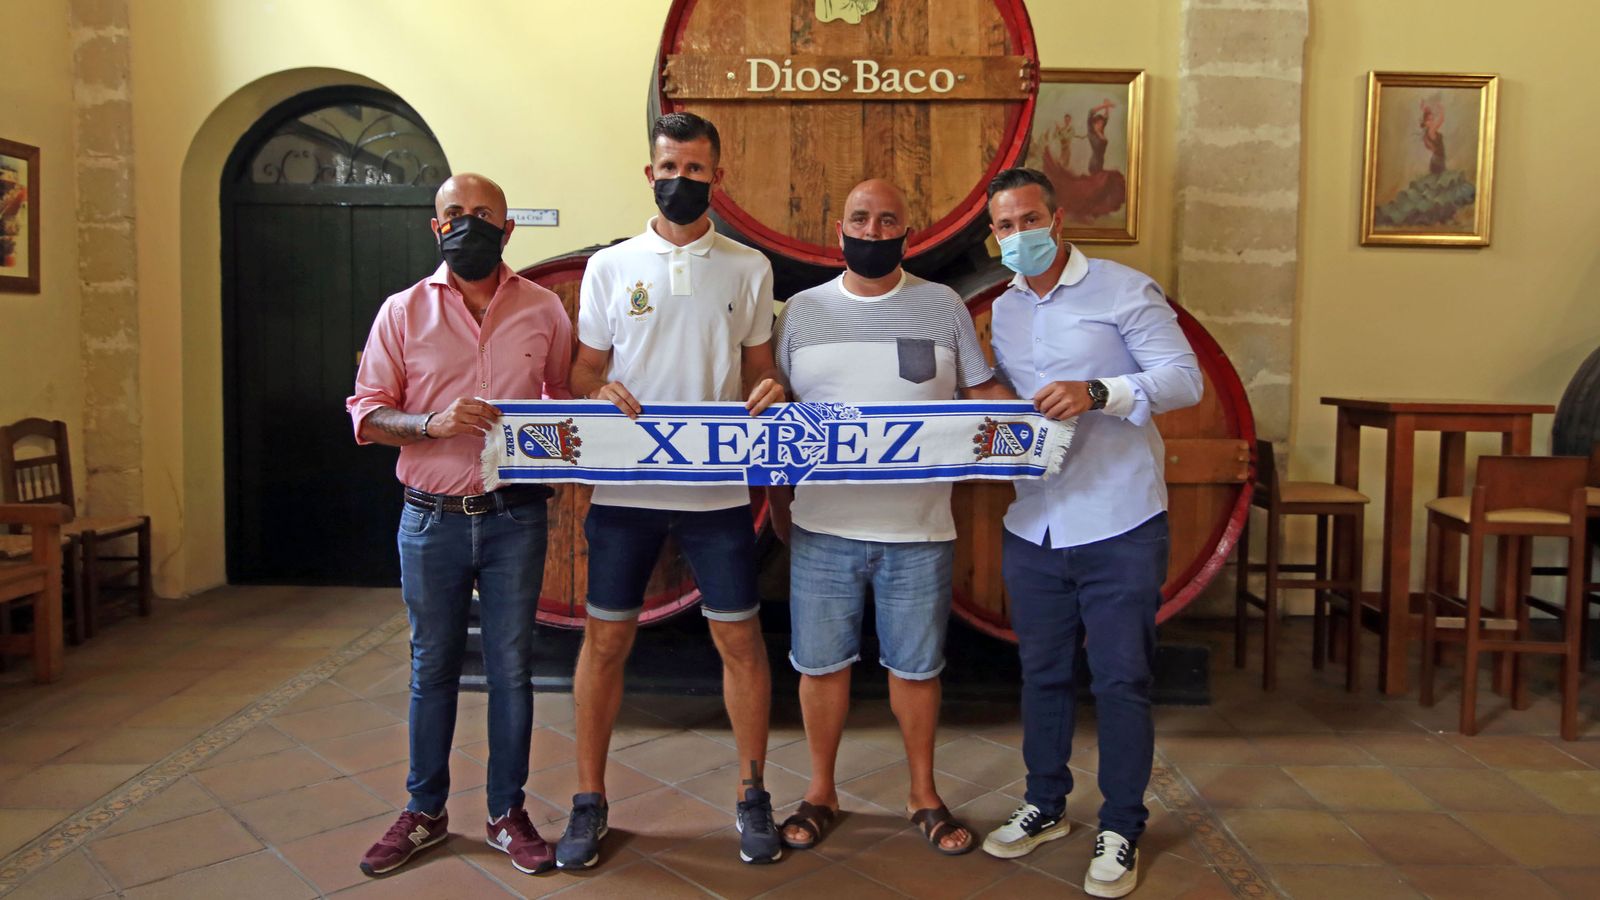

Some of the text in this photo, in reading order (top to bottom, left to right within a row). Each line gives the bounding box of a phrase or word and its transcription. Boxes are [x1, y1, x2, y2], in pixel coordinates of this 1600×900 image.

[746, 58, 956, 94] Dios Baco
[502, 424, 515, 457] XEREZ
[635, 420, 925, 466] XEREZ
[1033, 426, 1049, 458] XEREZ
[496, 827, 513, 851] N
